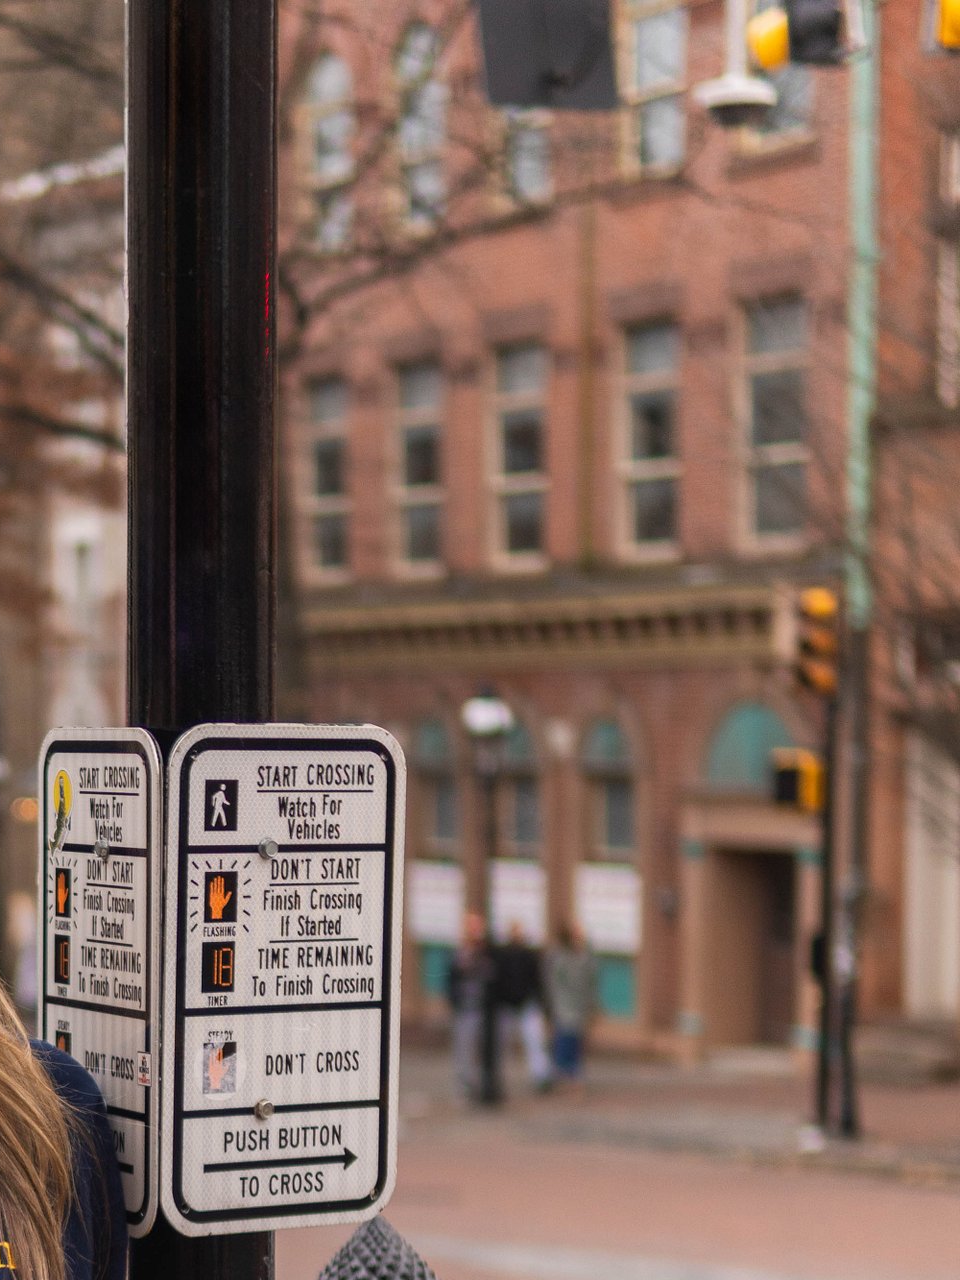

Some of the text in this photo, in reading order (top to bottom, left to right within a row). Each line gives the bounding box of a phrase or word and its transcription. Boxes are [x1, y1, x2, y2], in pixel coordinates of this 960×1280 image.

[79, 766, 140, 789] START CROSSING
[256, 763, 375, 787] START CROSSING
[89, 796, 123, 820] Watch For
[278, 794, 343, 817] Watch For
[95, 820, 123, 843] Vehicles
[288, 818, 340, 840] Vehicles
[87, 859, 134, 884] DON'T START
[271, 858, 361, 880] DON'T START
[83, 888, 135, 920] Finish Crossing
[263, 888, 362, 915] Finish Crossing
[92, 915, 124, 940] If Started
[203, 926, 236, 937] FLASHING
[280, 915, 342, 937] If Started
[81, 945, 142, 975] TIME REMAINING
[213, 947, 233, 987] 18
[258, 945, 373, 970] TIME REMAINING
[78, 971, 142, 1008] To Finish Crossing
[252, 972, 375, 999] To Finish Crossing
[208, 995, 228, 1006] TIMER
[85, 1050, 134, 1080] DON'T CROSS
[265, 1050, 360, 1076] DON'T CROSS
[224, 1124, 342, 1153] PUSH BUTTON
[240, 1171, 324, 1198] TO CROSS
